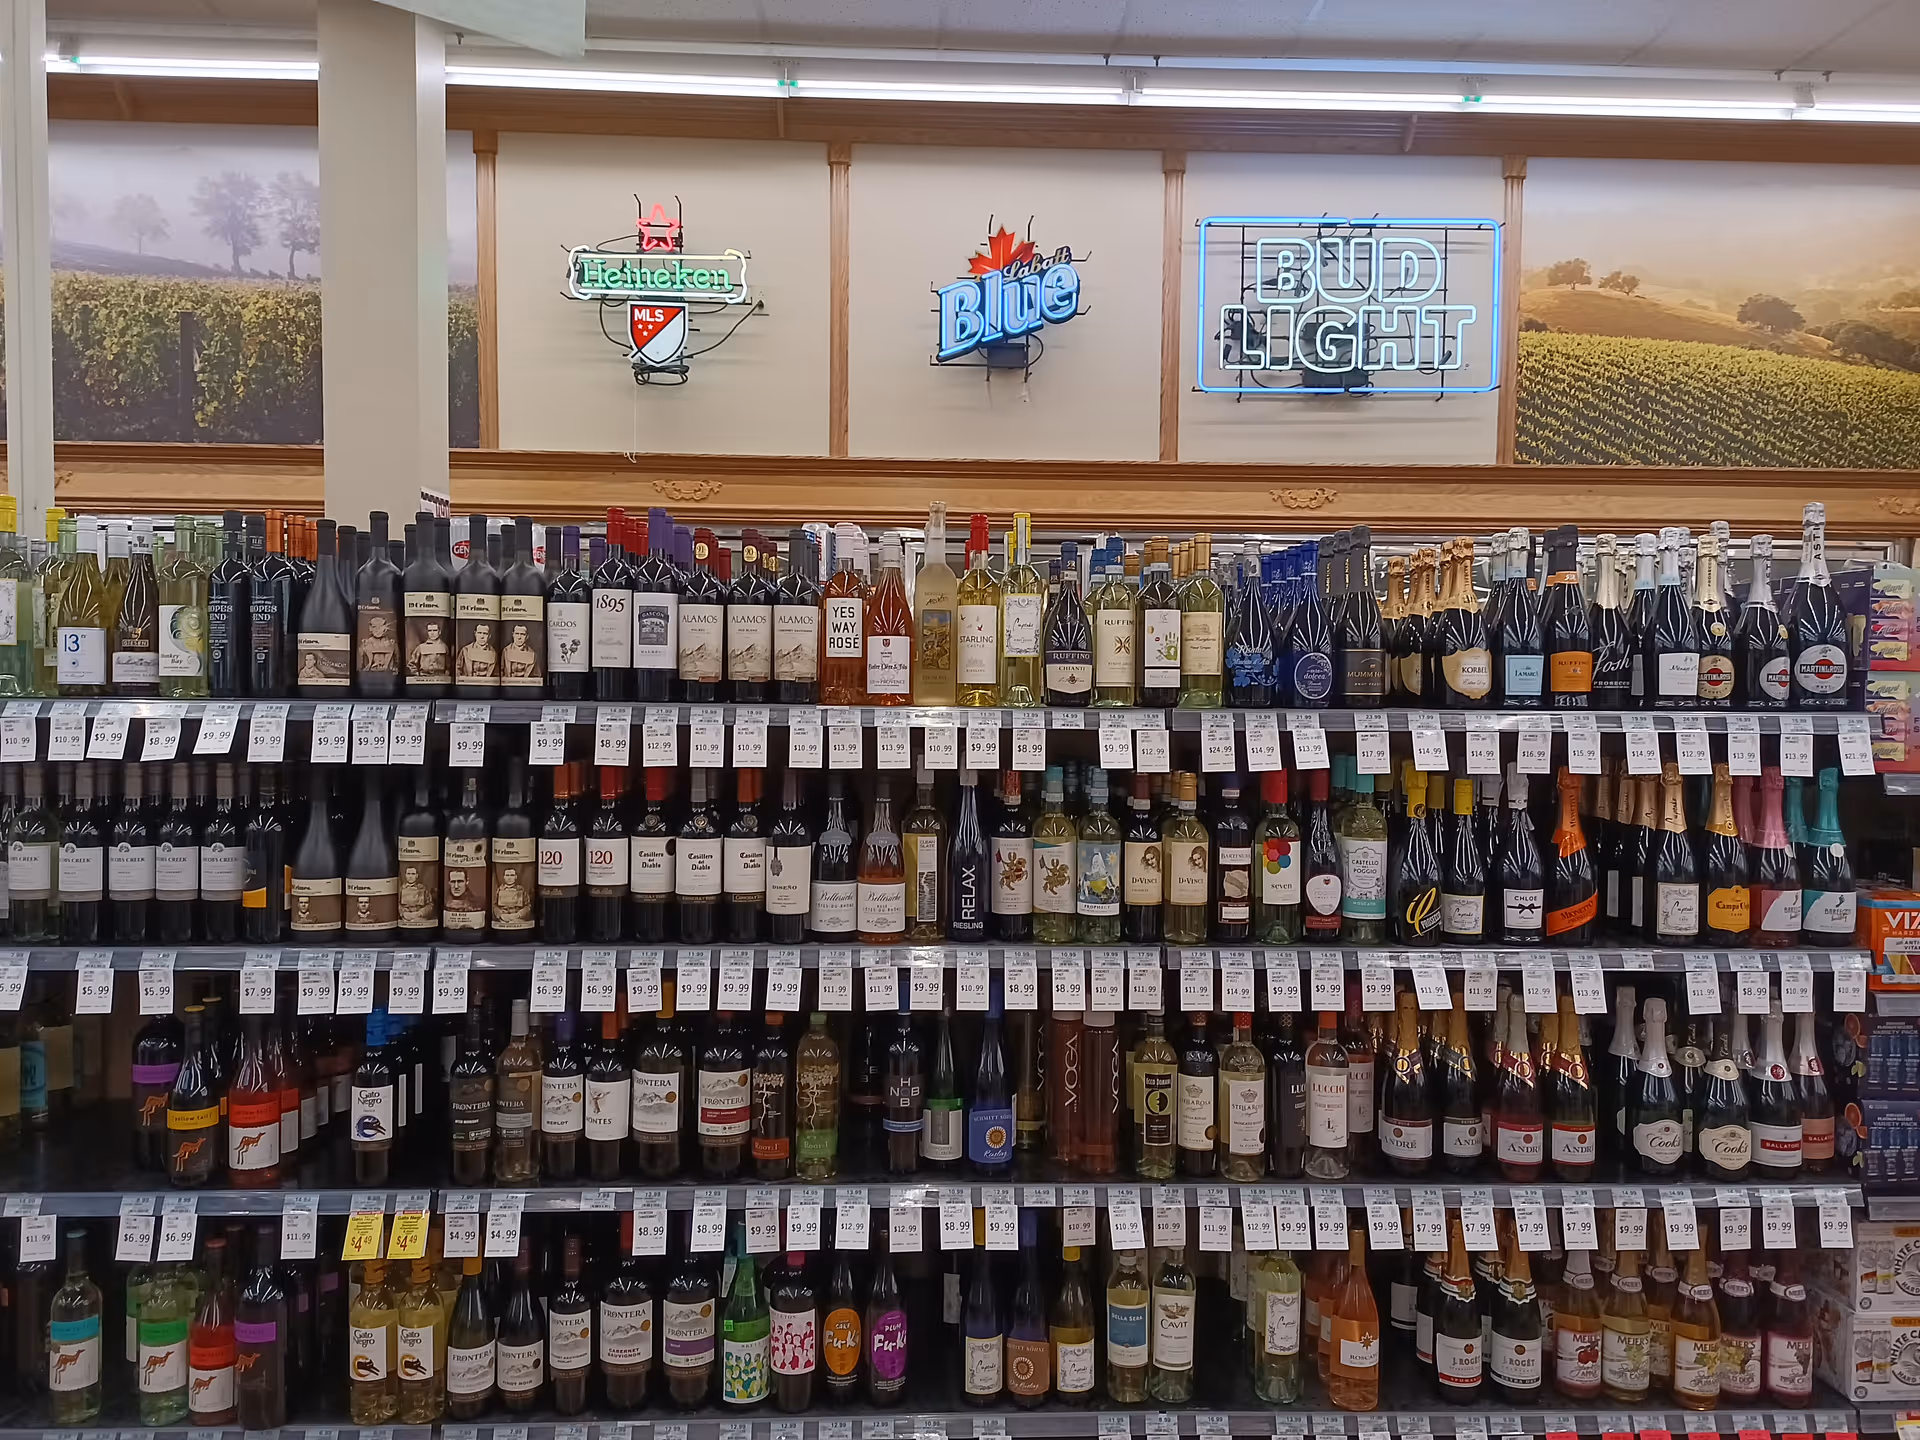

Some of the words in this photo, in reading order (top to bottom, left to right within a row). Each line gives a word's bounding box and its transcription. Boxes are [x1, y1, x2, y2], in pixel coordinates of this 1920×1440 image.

[1003, 248, 1070, 283] Labatt
[1256, 237, 1442, 304] BUD
[582, 260, 733, 292] Heineken
[938, 264, 1078, 358] Blue
[634, 309, 665, 323] MLS
[1220, 305, 1476, 373] LIGHT
[1813, 525, 1822, 561] ASTI
[596, 594, 625, 612] 1895
[832, 607, 855, 618] YES
[682, 614, 718, 624] ALAMOS
[731, 614, 766, 624] ALAMOS
[778, 615, 814, 624] ALAMOS
[831, 622, 856, 634] WAY
[64, 634, 80, 652] 13
[829, 634, 859, 649] ROSÉ
[960, 636, 993, 644] STARLING
[150, 736, 175, 745] $8.99
[318, 736, 345, 745] $9.99
[359, 736, 385, 745] $9.99
[601, 739, 626, 748] $8.99
[458, 741, 483, 750] $9.99
[972, 743, 996, 751] $9.99
[1104, 744, 1129, 752] $9.99
[1299, 745, 1323, 754] $13.99
[1210, 746, 1233, 755] $24.99
[540, 850, 562, 864] 120
[589, 850, 613, 864] 120
[638, 850, 664, 858] Casillero
[691, 863, 711, 871] Diablo
[962, 865, 975, 920] RELAX
[953, 921, 984, 930] RIESLING
[145, 986, 170, 996] $5.99
[303, 987, 330, 996] $9.99
[393, 987, 419, 996] $9.99
[439, 987, 464, 996] $9.99
[587, 985, 612, 994] $6.99
[682, 984, 707, 993] $9.99
[773, 983, 797, 992] $9.99
[915, 983, 939, 991] $9.99
[1009, 984, 1034, 993] $8.99
[1316, 984, 1340, 993] $9.99
[1064, 1033, 1078, 1107] VOGA
[1313, 1082, 1345, 1093] LUCCIO
[359, 1090, 380, 1098] Gato
[358, 1097, 382, 1107] Negro
[1382, 1137, 1417, 1149] ANDRÉ
[1714, 1139, 1749, 1154] Cook's
[697, 1224, 722, 1233] $8.99
[792, 1223, 817, 1232] $9.99
[945, 1221, 970, 1230] $8.99
[1069, 1223, 1091, 1232] $10.99
[1281, 1223, 1306, 1231] $9.99
[1373, 1222, 1398, 1230] $9.99
[1466, 1223, 1490, 1232] $7.99
[1567, 1222, 1591, 1231] $7.99
[1620, 1225, 1643, 1233] $9.99
[1725, 1225, 1747, 1233] $9.99
[1824, 1222, 1848, 1230] $9.99
[124, 1233, 150, 1243] $6.99
[166, 1232, 192, 1242] $6.99
[491, 1230, 516, 1239] $4.99
[1161, 1319, 1188, 1330] CAVIT
[353, 1330, 373, 1338] Gato
[400, 1330, 420, 1338] Gato
[352, 1337, 375, 1347] Negro
[399, 1337, 422, 1347] Negro
[1509, 1357, 1535, 1367] ROGÉT
